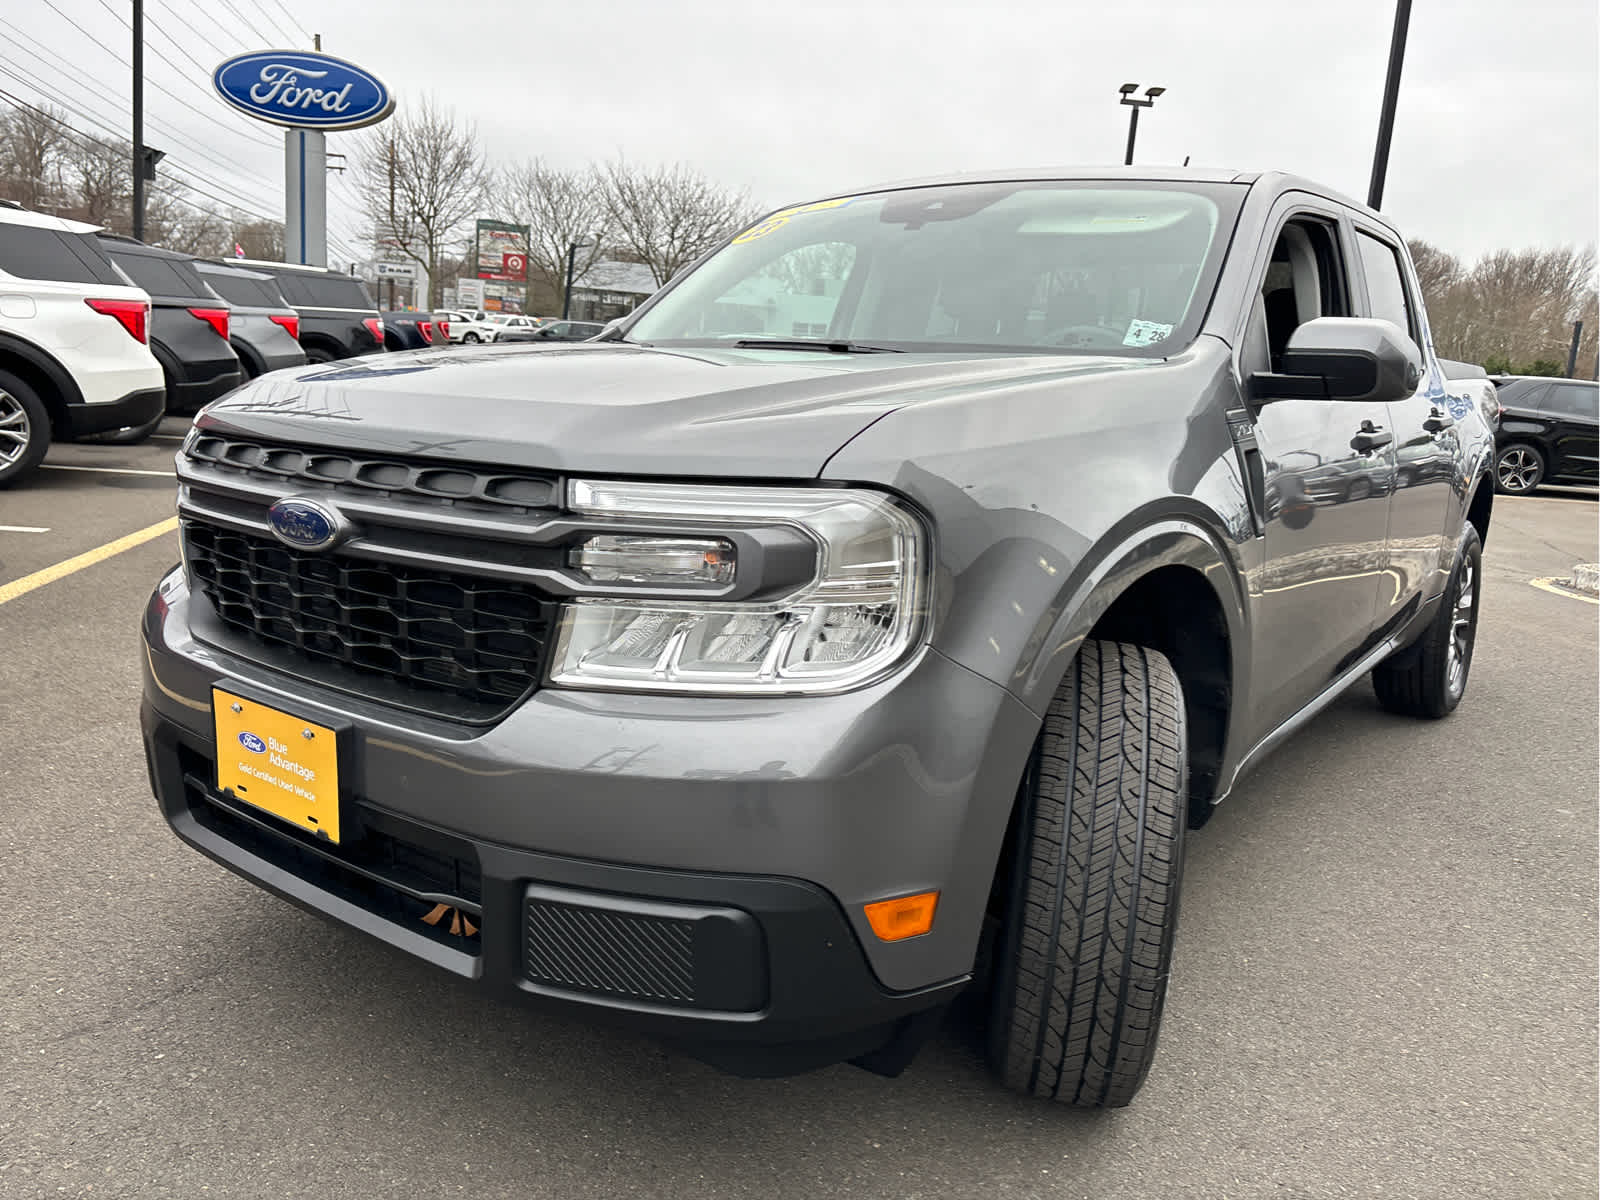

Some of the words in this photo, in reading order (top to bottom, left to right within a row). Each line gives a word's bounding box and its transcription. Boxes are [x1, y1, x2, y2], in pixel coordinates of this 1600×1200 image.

[250, 64, 353, 113] Ford
[1133, 328, 1142, 339] 4
[1149, 331, 1166, 342] 28
[243, 734, 261, 751] Ford
[268, 737, 288, 755] Blue
[269, 752, 315, 781] Advantage
[238, 762, 252, 775] Gold
[253, 768, 277, 784] Certified
[278, 779, 293, 792] Used
[294, 784, 316, 802] Vehicle
